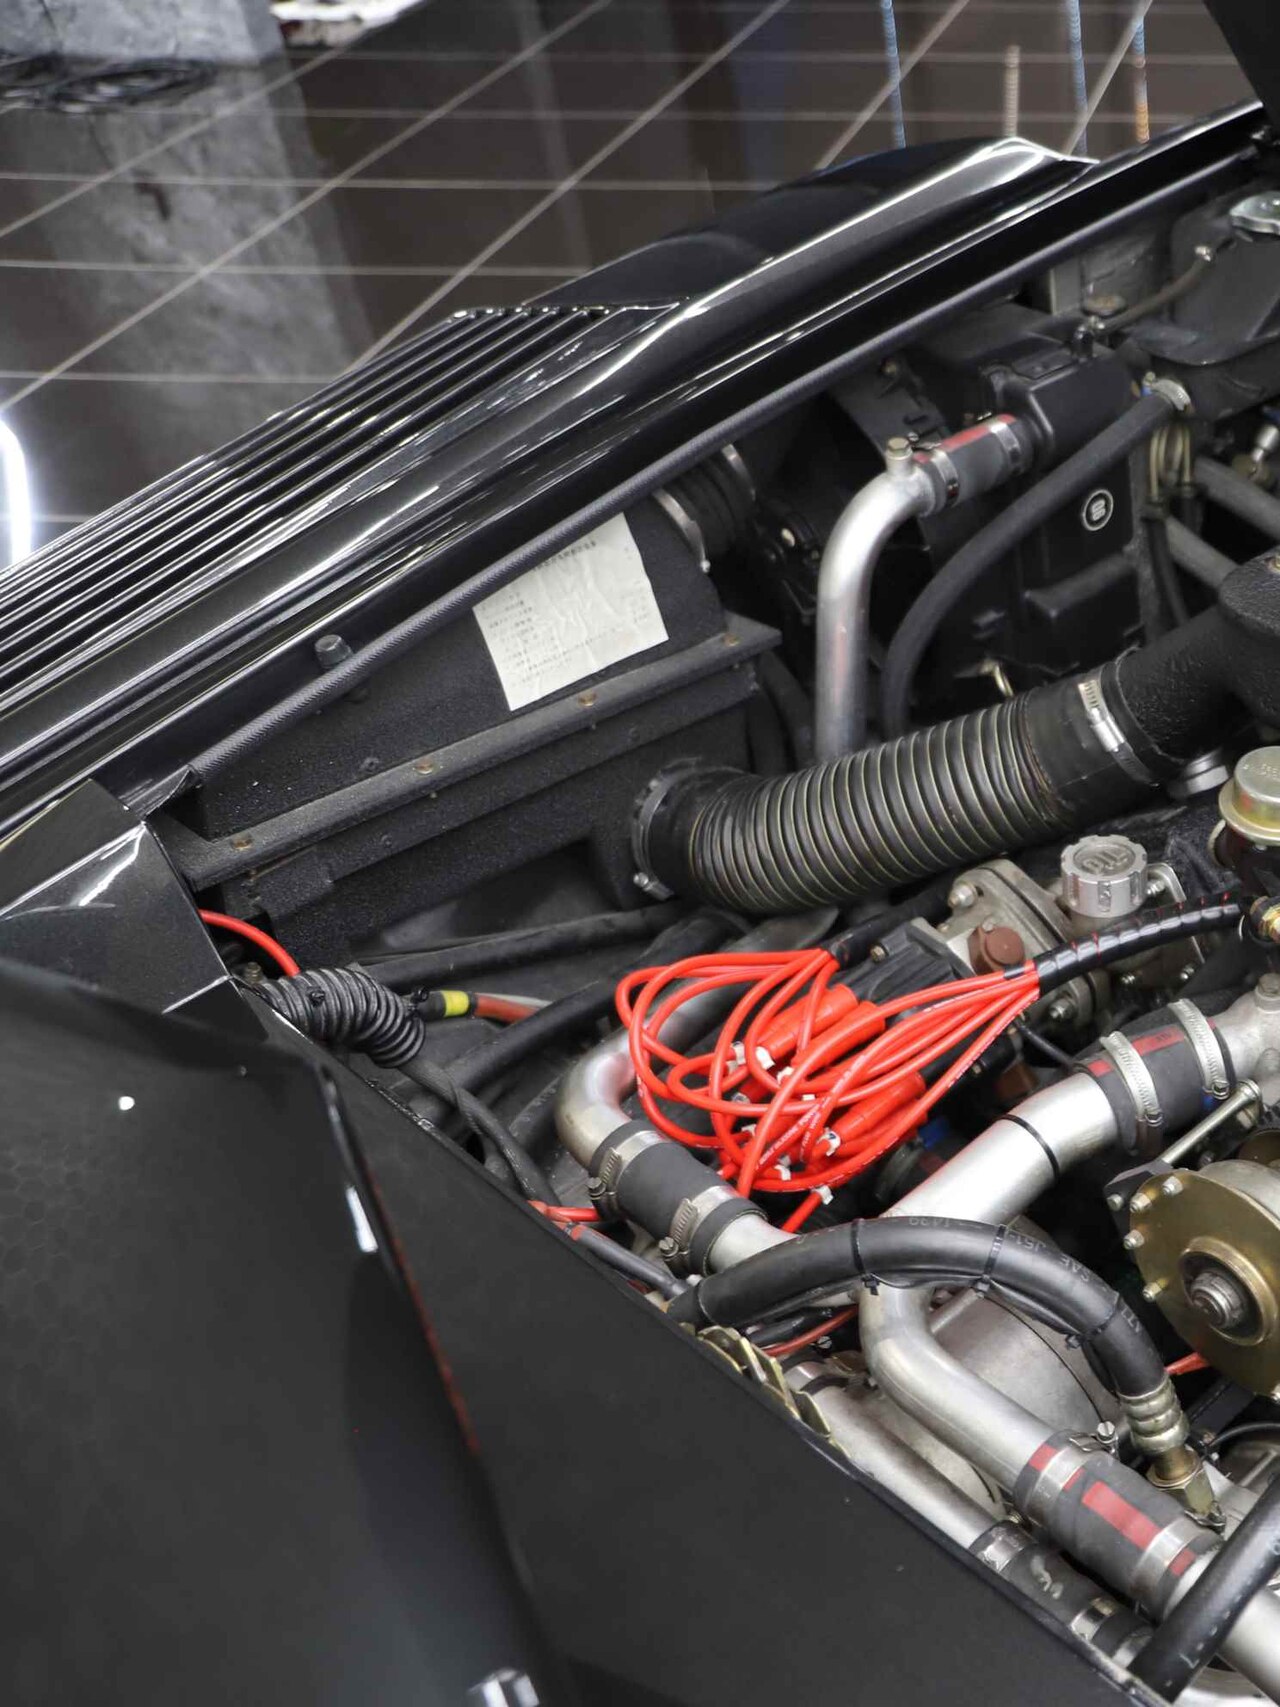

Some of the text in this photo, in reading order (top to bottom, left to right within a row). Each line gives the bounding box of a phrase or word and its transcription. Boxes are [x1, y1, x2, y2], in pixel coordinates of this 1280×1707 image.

[1082, 848, 1129, 875] OIL
[1008, 1233, 1047, 1253] J51-
[1058, 1253, 1092, 1282] SAE
